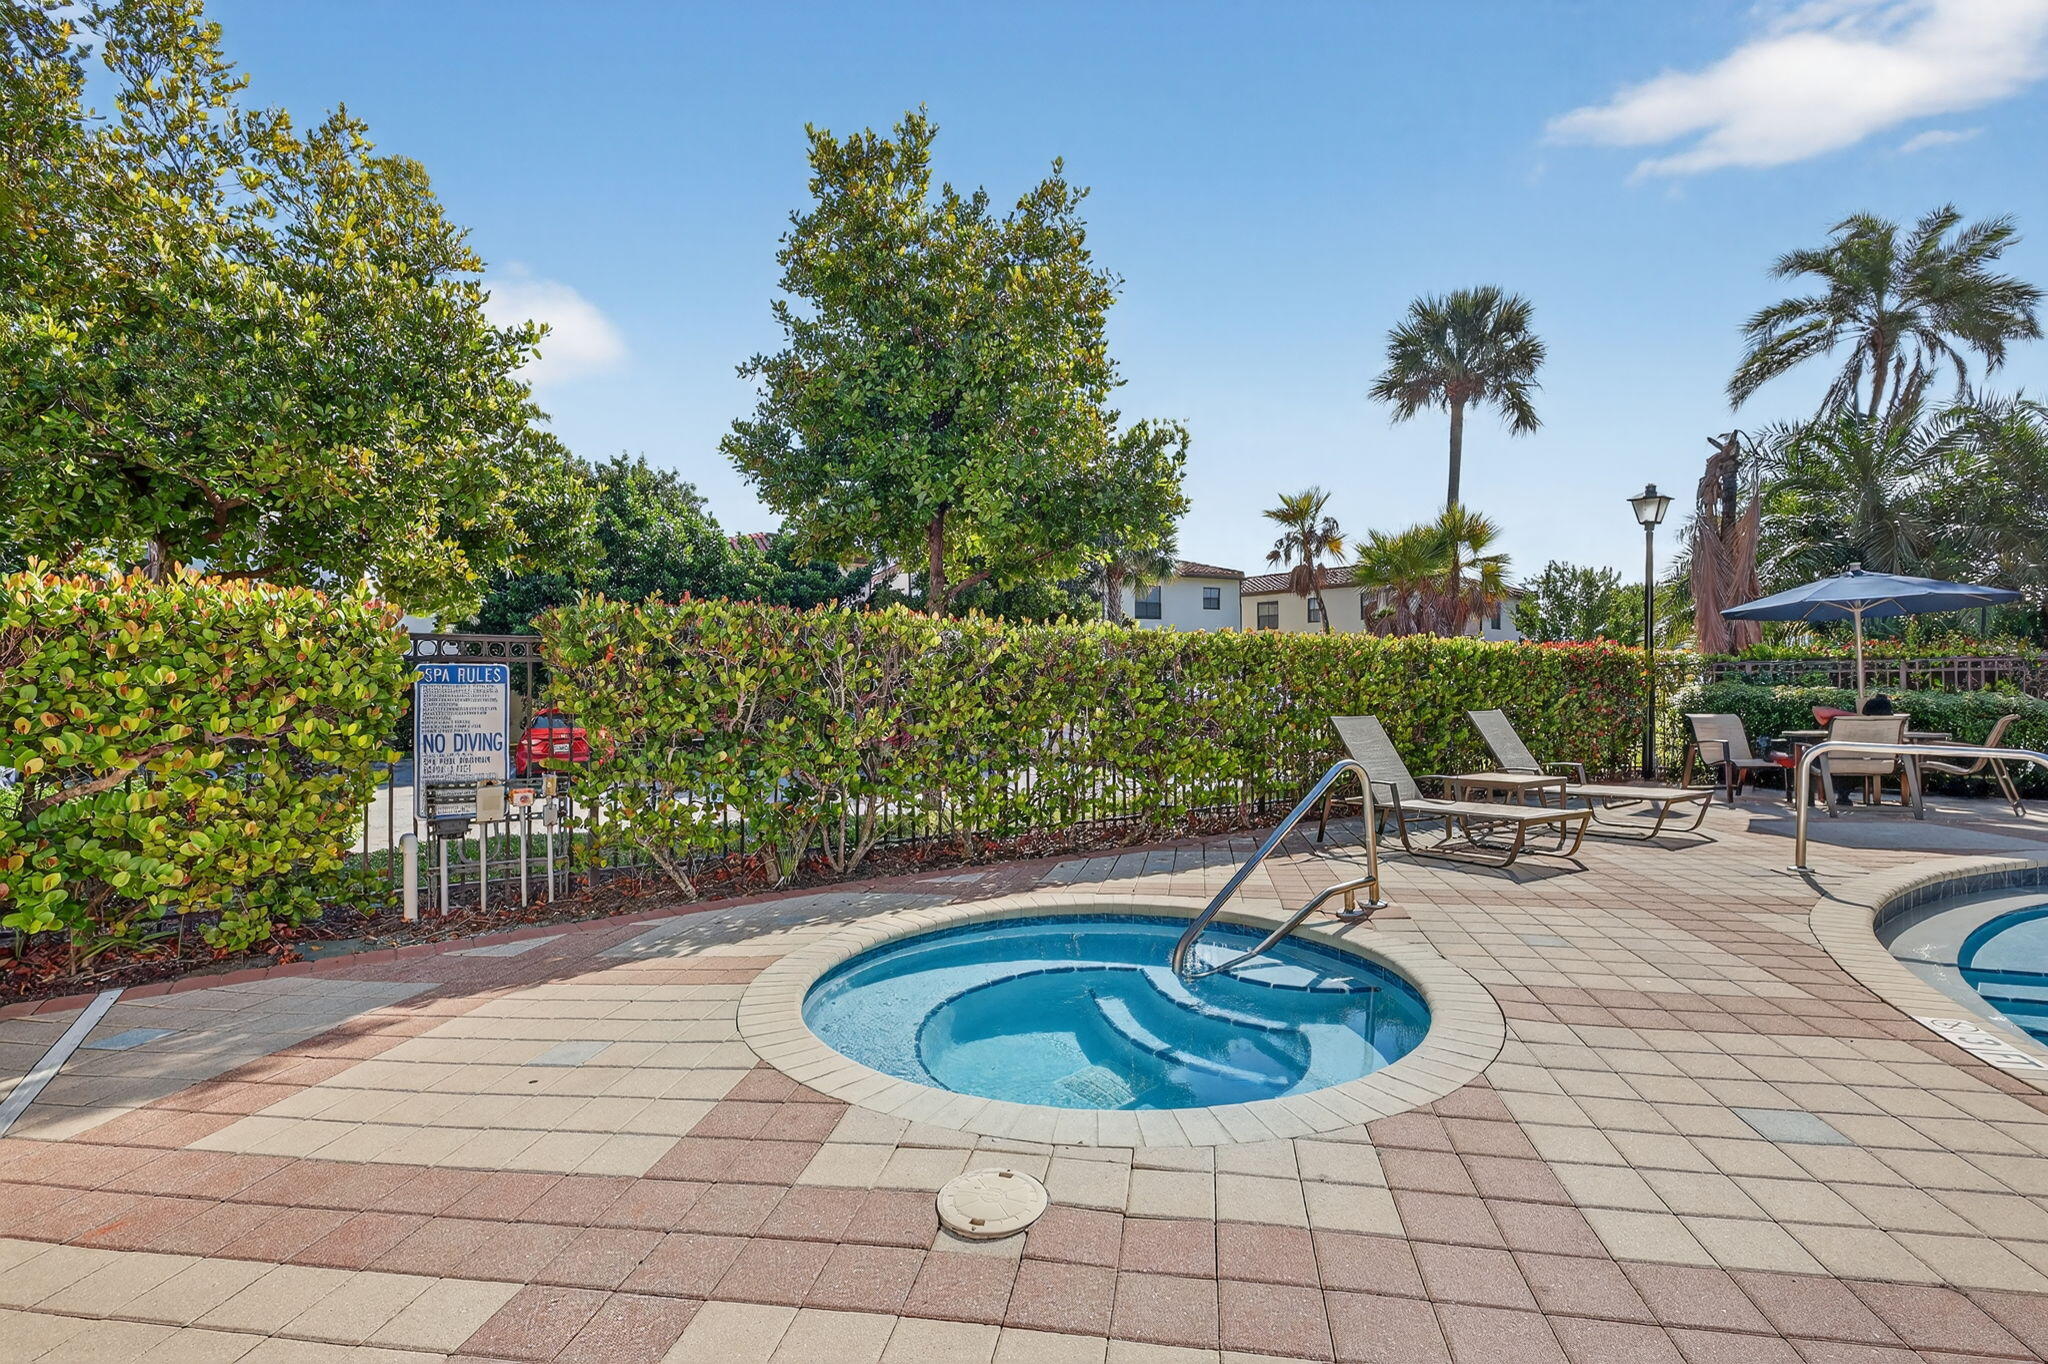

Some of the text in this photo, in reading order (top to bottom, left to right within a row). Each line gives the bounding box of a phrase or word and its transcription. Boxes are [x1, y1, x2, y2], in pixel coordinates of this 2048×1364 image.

[424, 667, 502, 683] SPA RULES
[422, 732, 503, 753] NO DIVING
[1958, 1036, 2002, 1046] 3
